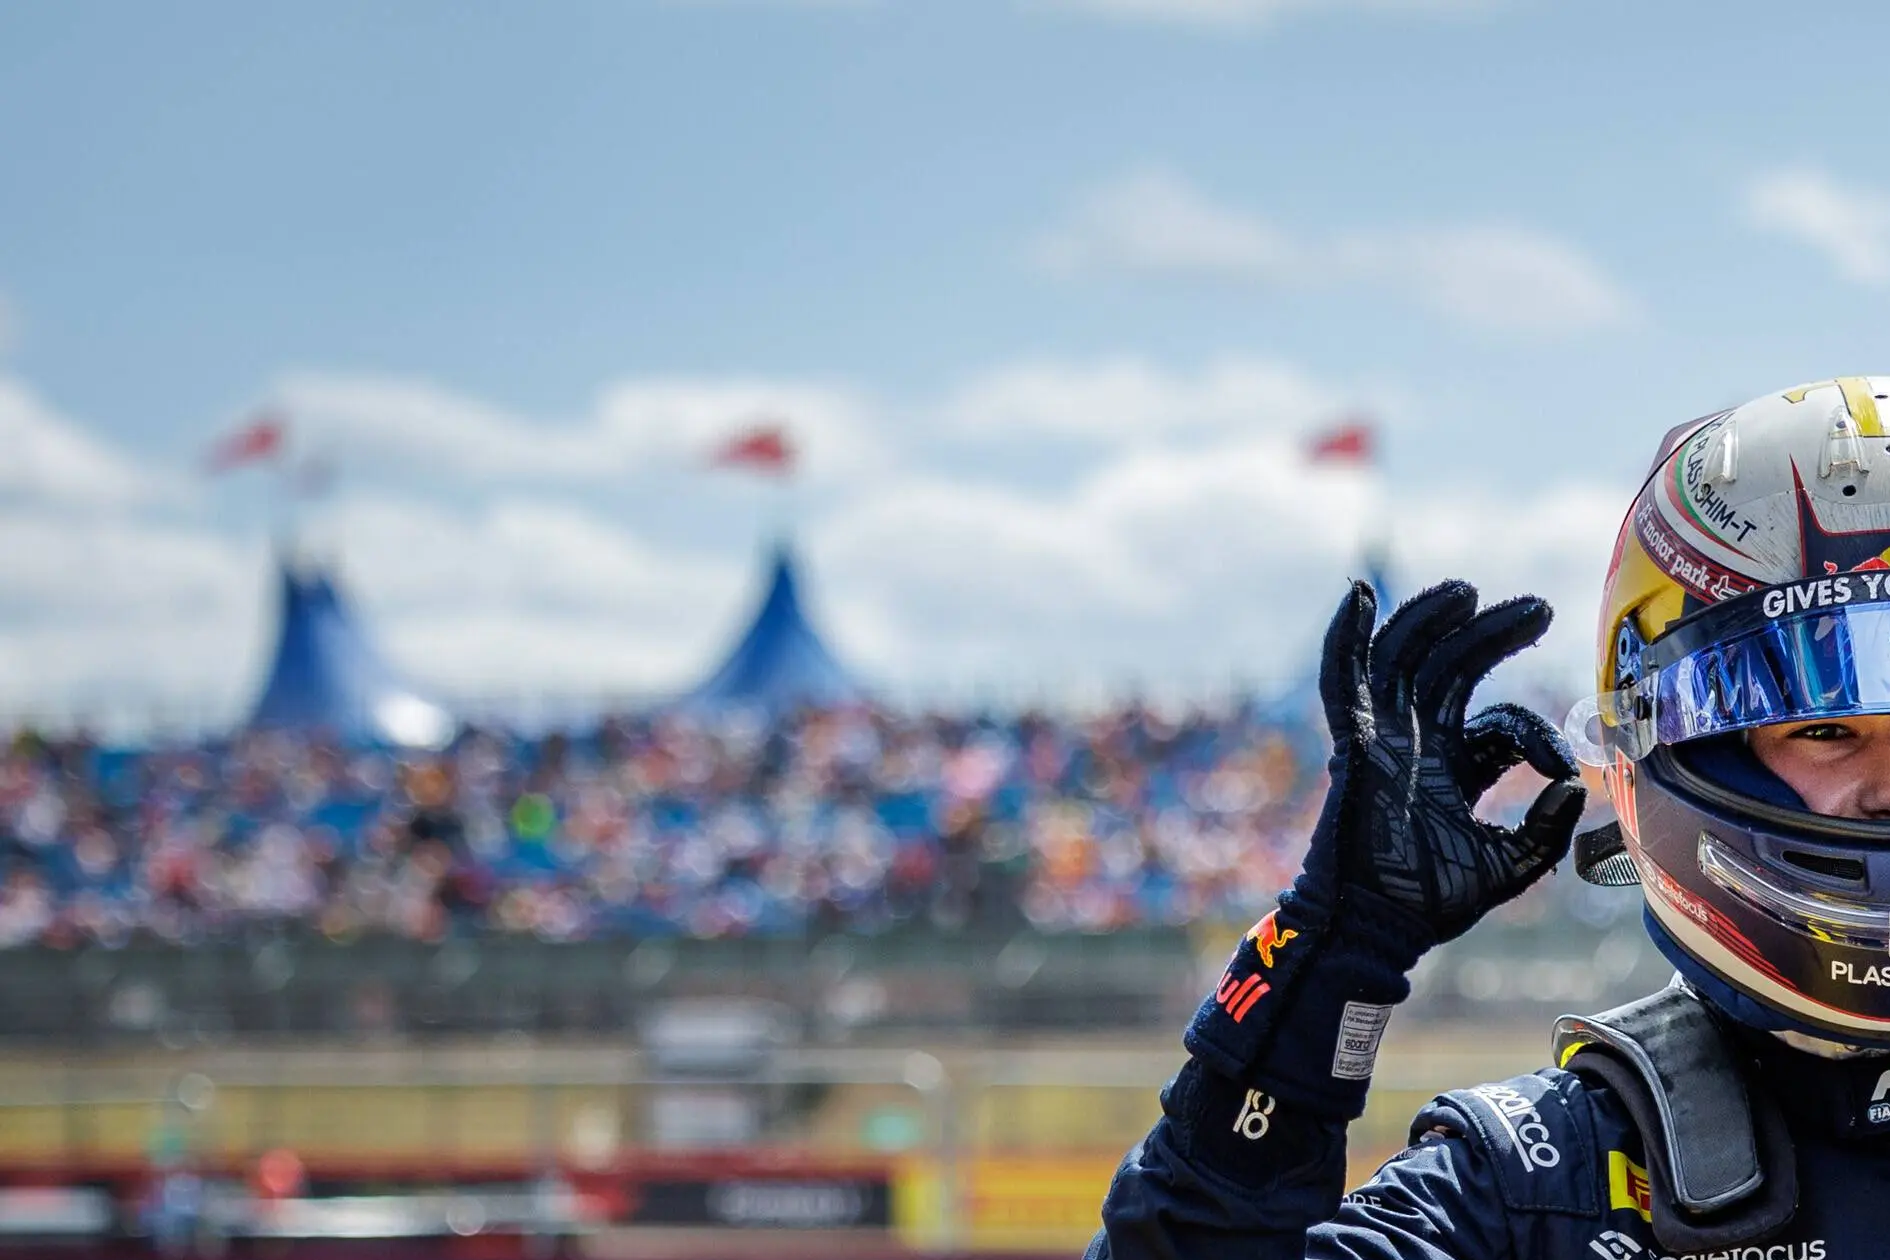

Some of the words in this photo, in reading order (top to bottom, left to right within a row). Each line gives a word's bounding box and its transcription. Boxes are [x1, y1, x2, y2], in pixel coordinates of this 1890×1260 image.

[1644, 520, 1675, 562] motor
[1671, 555, 1711, 591] park
[1763, 577, 1851, 618] GIVES
[1216, 972, 1272, 1023] ull
